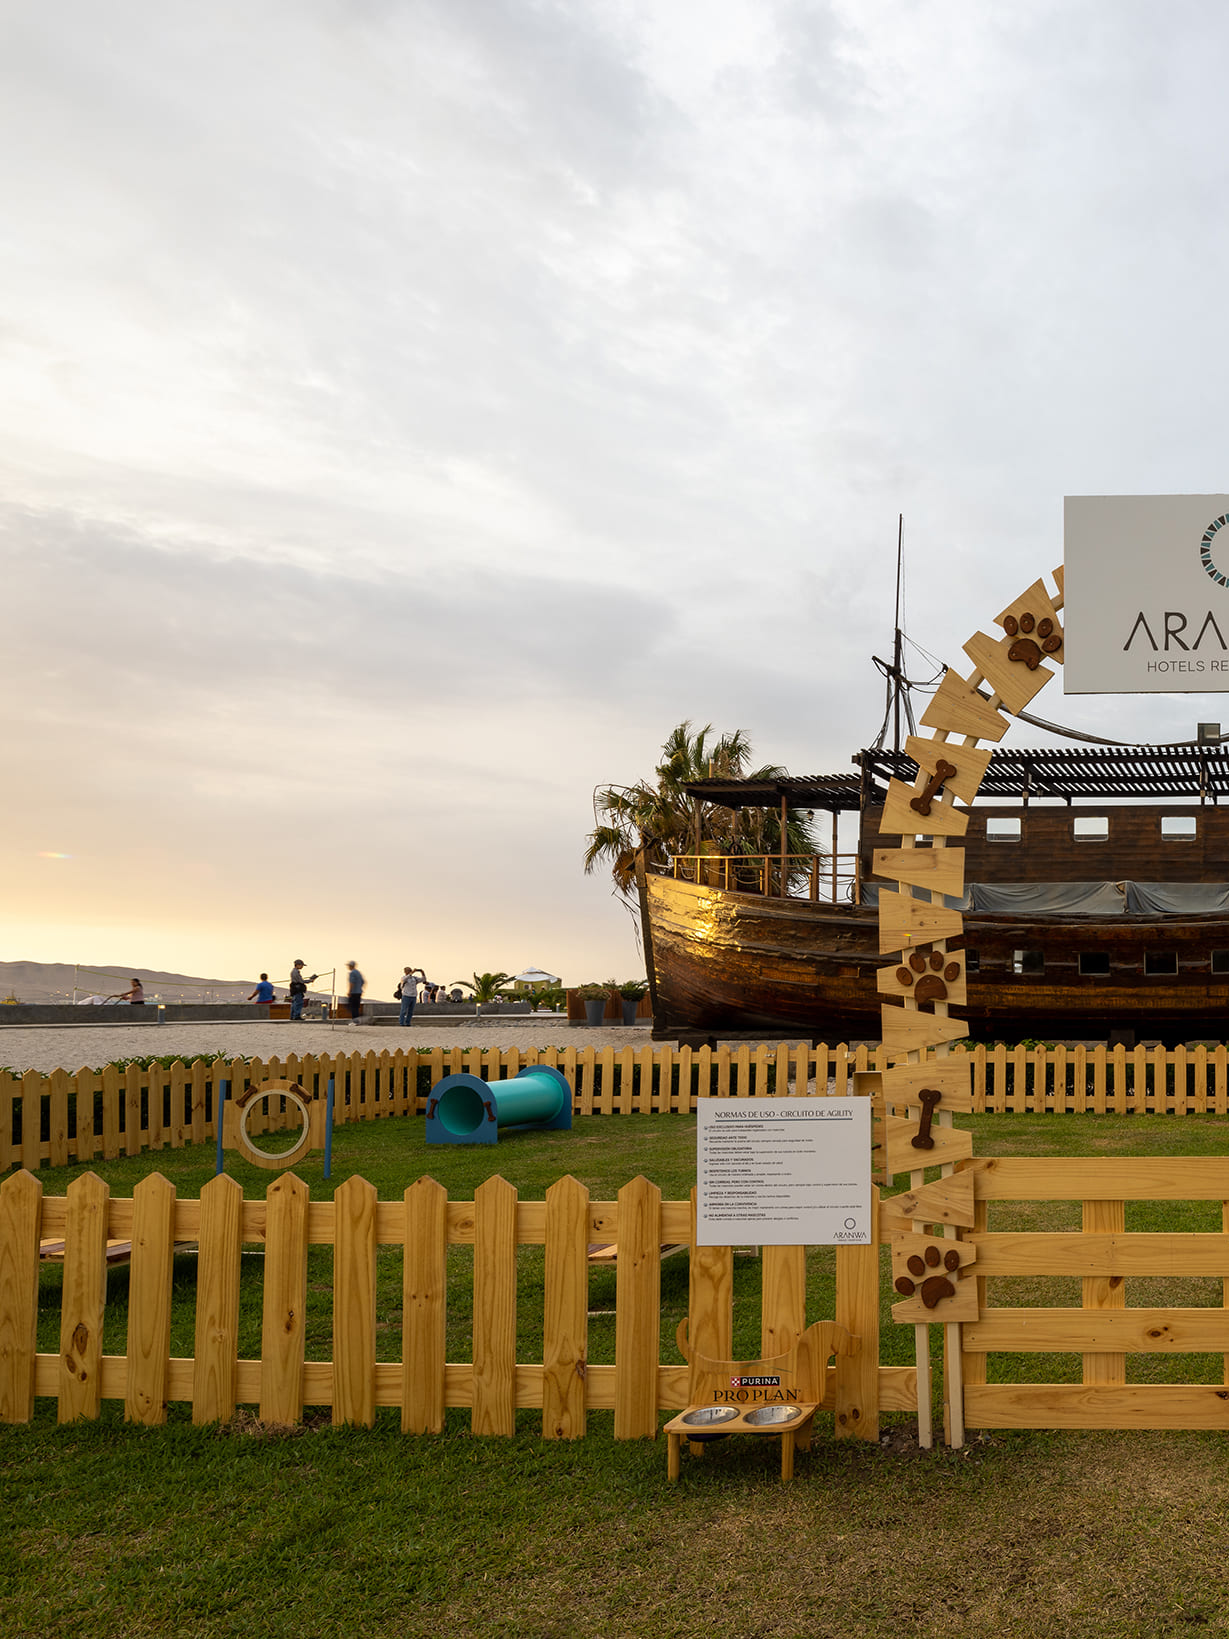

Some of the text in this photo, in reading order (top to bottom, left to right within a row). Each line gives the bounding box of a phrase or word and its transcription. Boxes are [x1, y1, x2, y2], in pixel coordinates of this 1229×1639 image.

[1147, 660, 1205, 673] HOTELS
[713, 1389, 798, 1402] PRO PLAN
